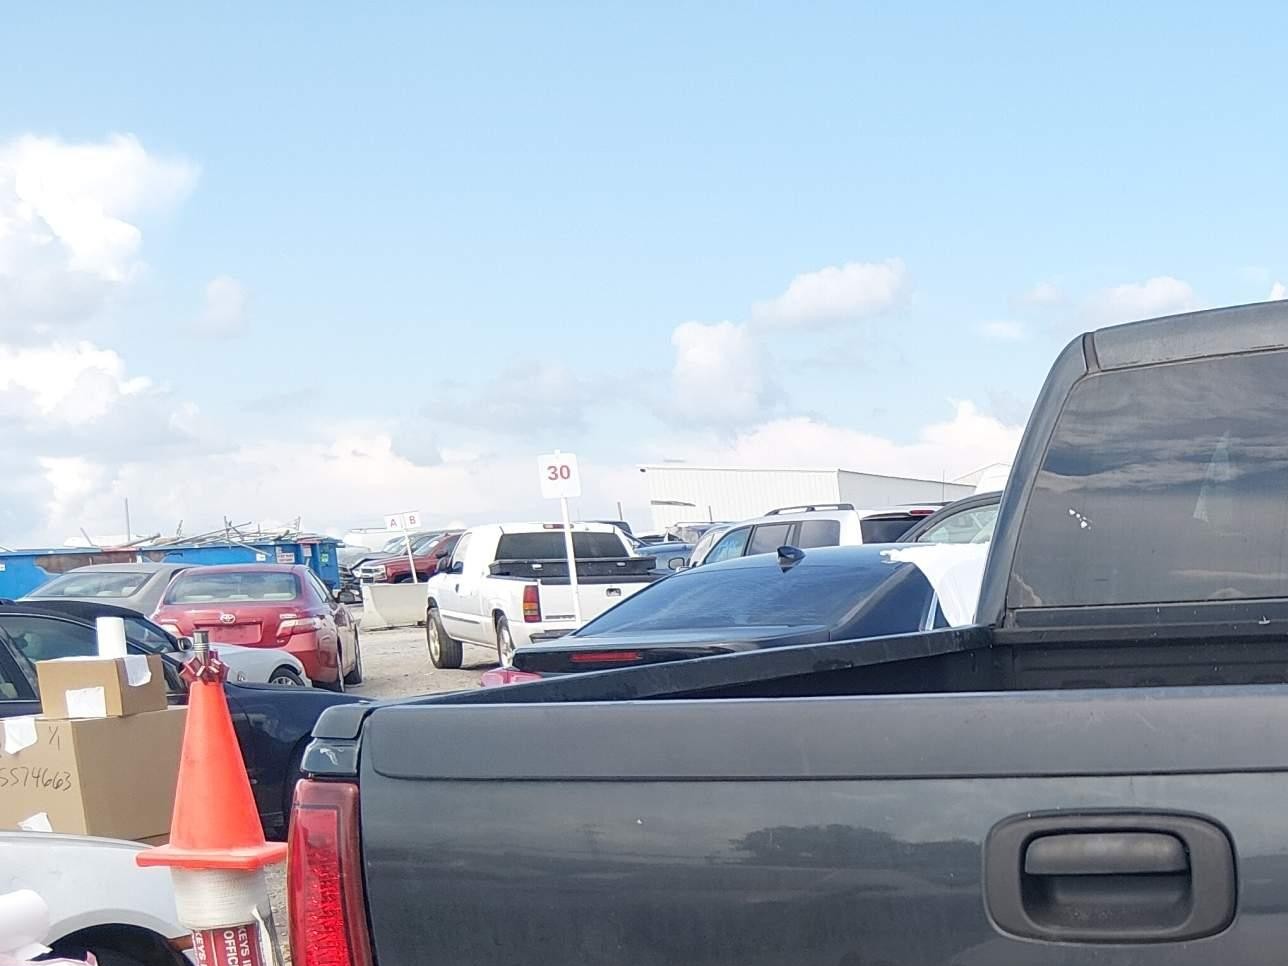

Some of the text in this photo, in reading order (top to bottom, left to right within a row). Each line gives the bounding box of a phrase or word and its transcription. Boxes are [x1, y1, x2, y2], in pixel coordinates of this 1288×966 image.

[547, 465, 570, 480] 30
[390, 518, 398, 528] A
[409, 515, 416, 525] B
